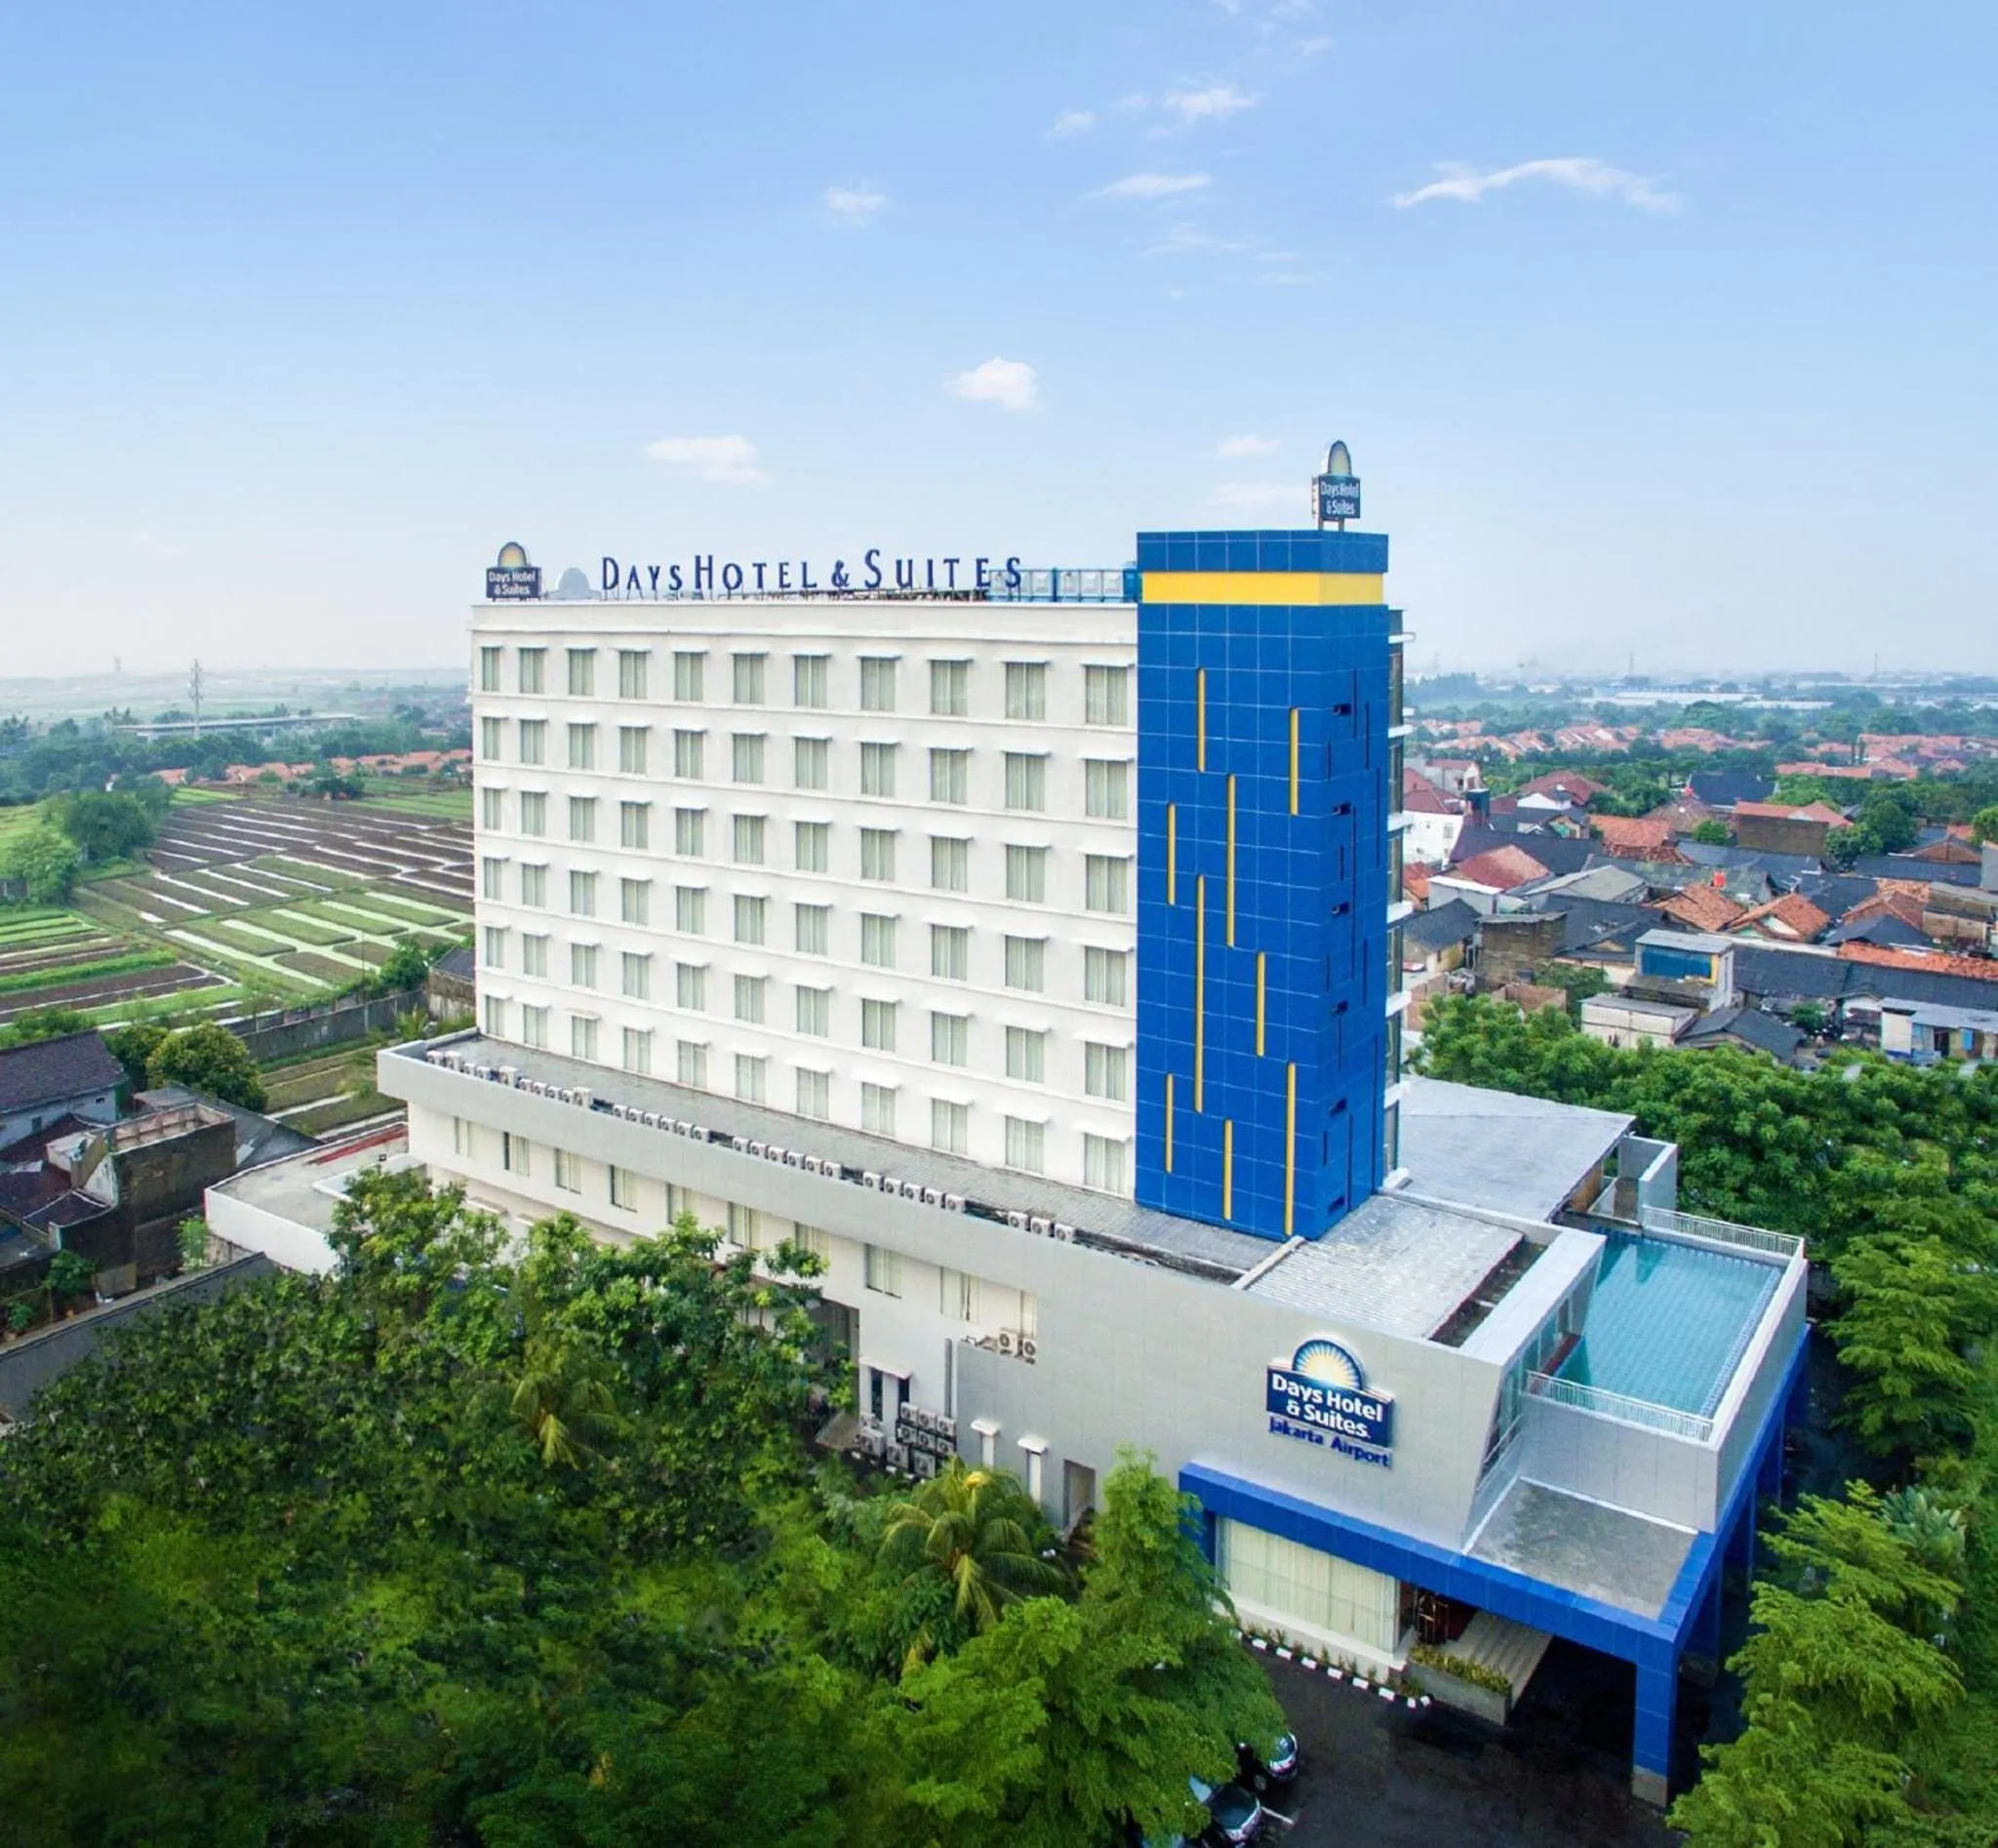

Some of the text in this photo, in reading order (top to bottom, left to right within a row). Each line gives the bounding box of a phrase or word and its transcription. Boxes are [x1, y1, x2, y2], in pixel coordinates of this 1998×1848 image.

[695, 554, 818, 589] HOTEL
[830, 559, 850, 587] &
[863, 548, 1021, 589] SUITES
[1272, 1373, 1383, 1423] Days Hotel
[1286, 1399, 1369, 1438] & Suites
[1331, 1435, 1389, 1466] Airport
